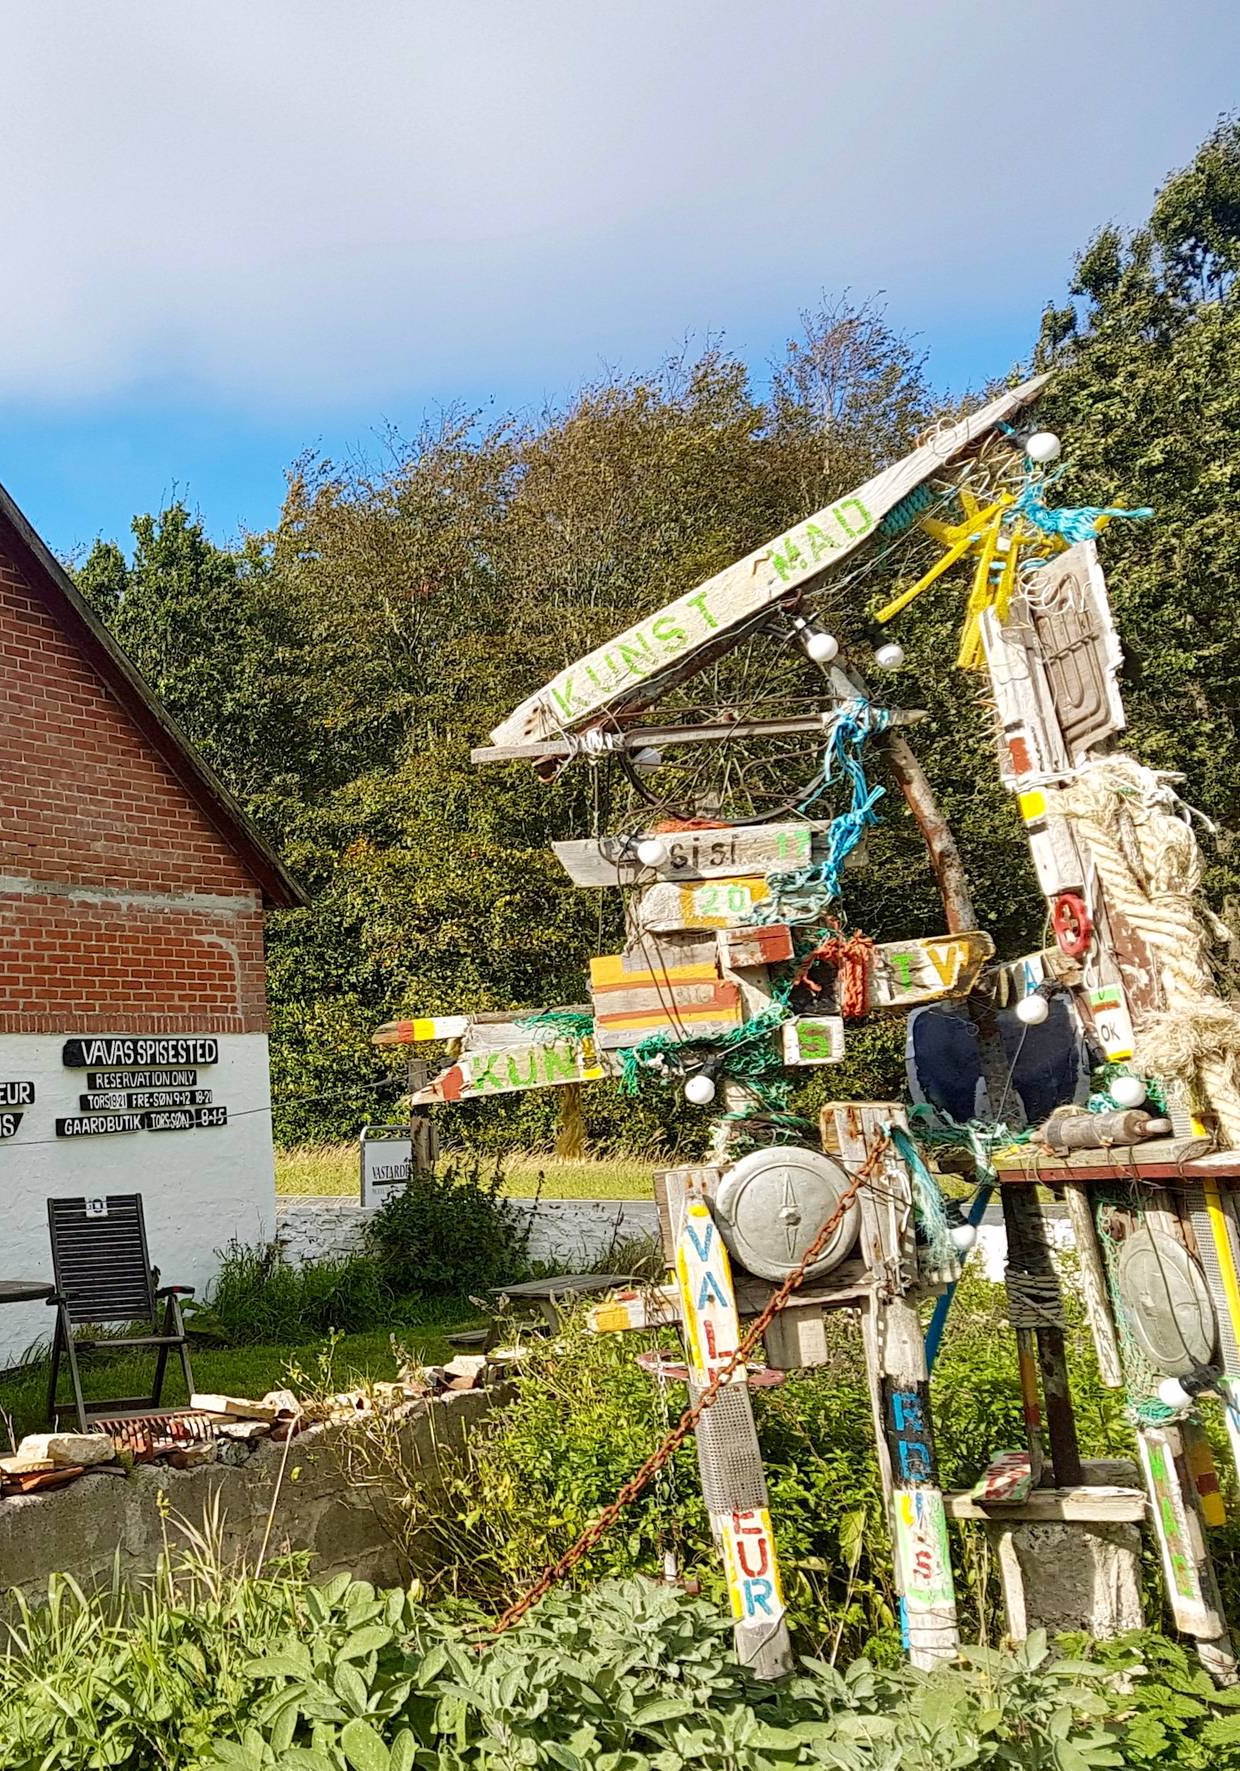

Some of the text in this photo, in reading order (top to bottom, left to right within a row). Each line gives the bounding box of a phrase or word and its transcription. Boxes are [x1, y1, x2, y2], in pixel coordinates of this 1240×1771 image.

[552, 498, 873, 718] KUNST MAD
[701, 885, 746, 914] 20
[1100, 1021, 1121, 1042] OK
[82, 1040, 217, 1066] VAVAS SPISESTED
[95, 1071, 196, 1089] RESERVATION ONLY
[87, 1095, 110, 1110] TORS
[64, 1115, 142, 1136] GAARDBUTIK
[201, 1109, 225, 1126] 8-15
